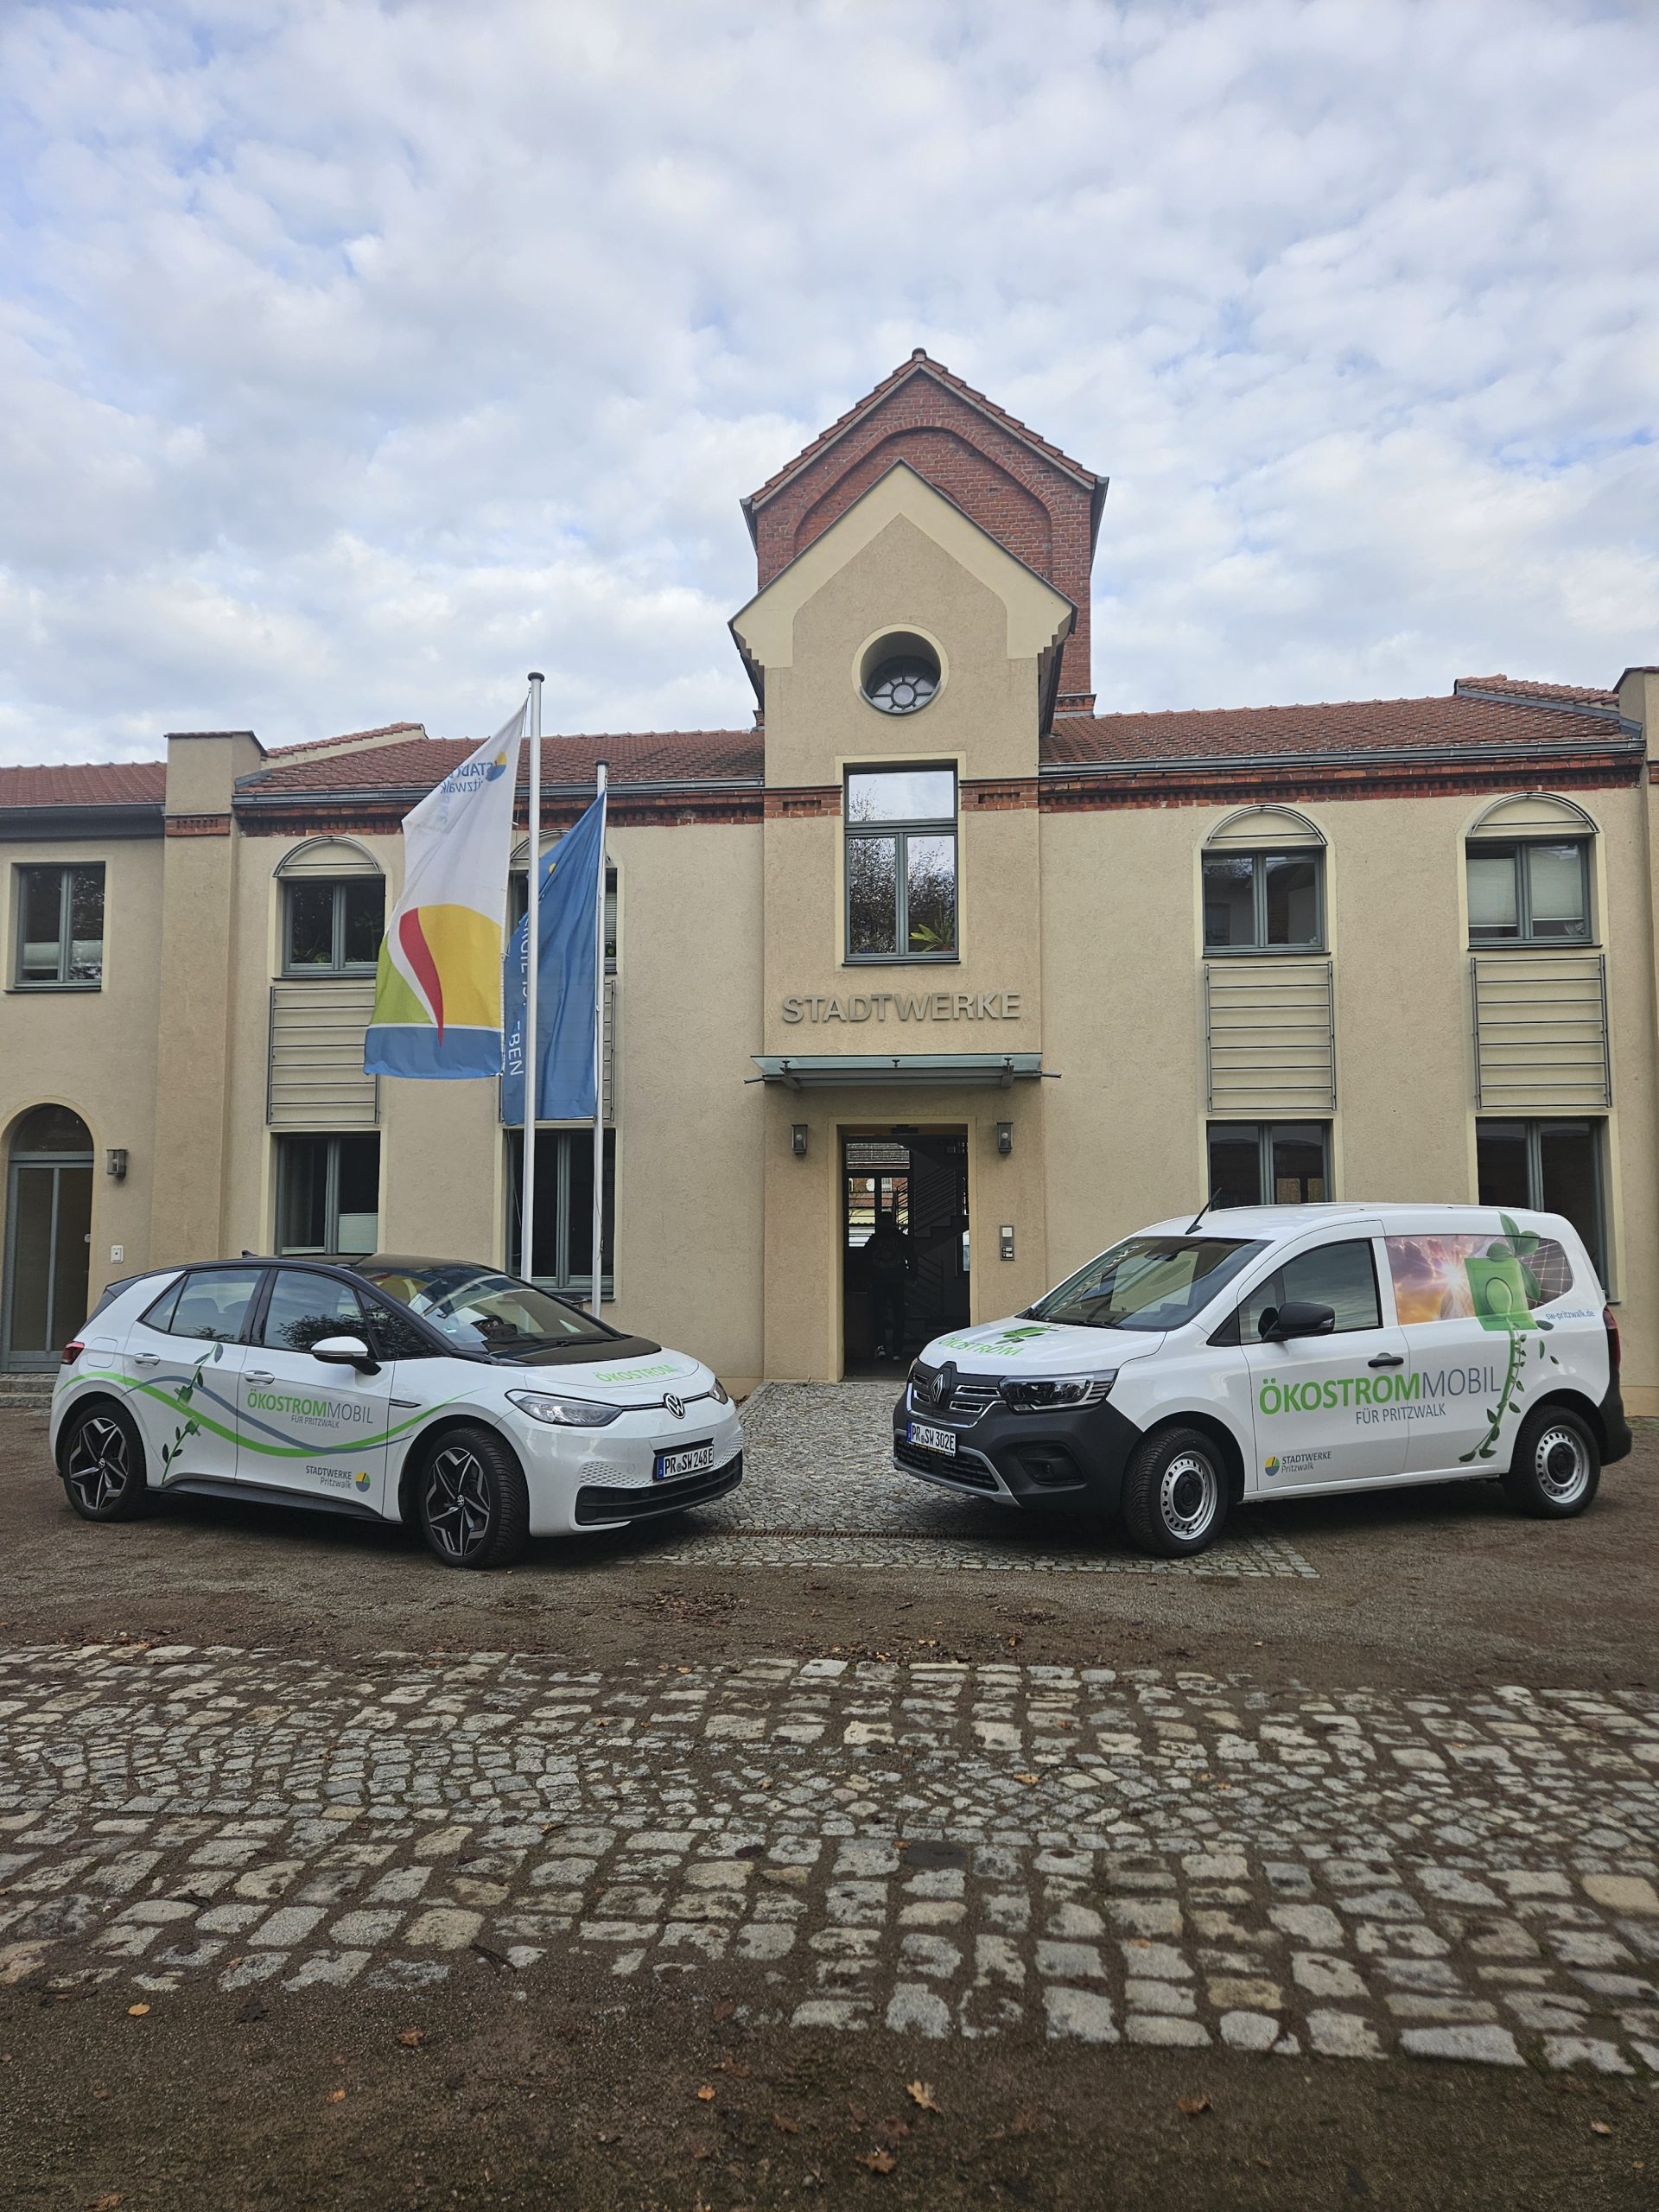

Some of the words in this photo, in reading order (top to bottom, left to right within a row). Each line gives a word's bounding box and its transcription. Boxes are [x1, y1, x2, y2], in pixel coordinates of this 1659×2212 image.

[782, 991, 1020, 1023] STADTWERKE
[1546, 1309, 1596, 1320] sw-pritzwalk.de
[938, 1337, 1024, 1356] ÖKOSTROM
[593, 1364, 678, 1382] ÖKOSTROM
[1259, 1366, 1502, 1415] ÖKOSTROMMOBIL
[247, 1389, 374, 1424] ÖKOSTROMMOBIL
[1356, 1408, 1380, 1425] FÜR
[1382, 1402, 1446, 1422] PRITZWALK
[304, 1417, 340, 1428] PRITZWALK
[1282, 1451, 1332, 1465] STADTWERKE
[306, 1465, 352, 1479] STADTWERKE
[1281, 1462, 1314, 1473] Pritzwalk
[320, 1477, 352, 1489] Pritzwalk
